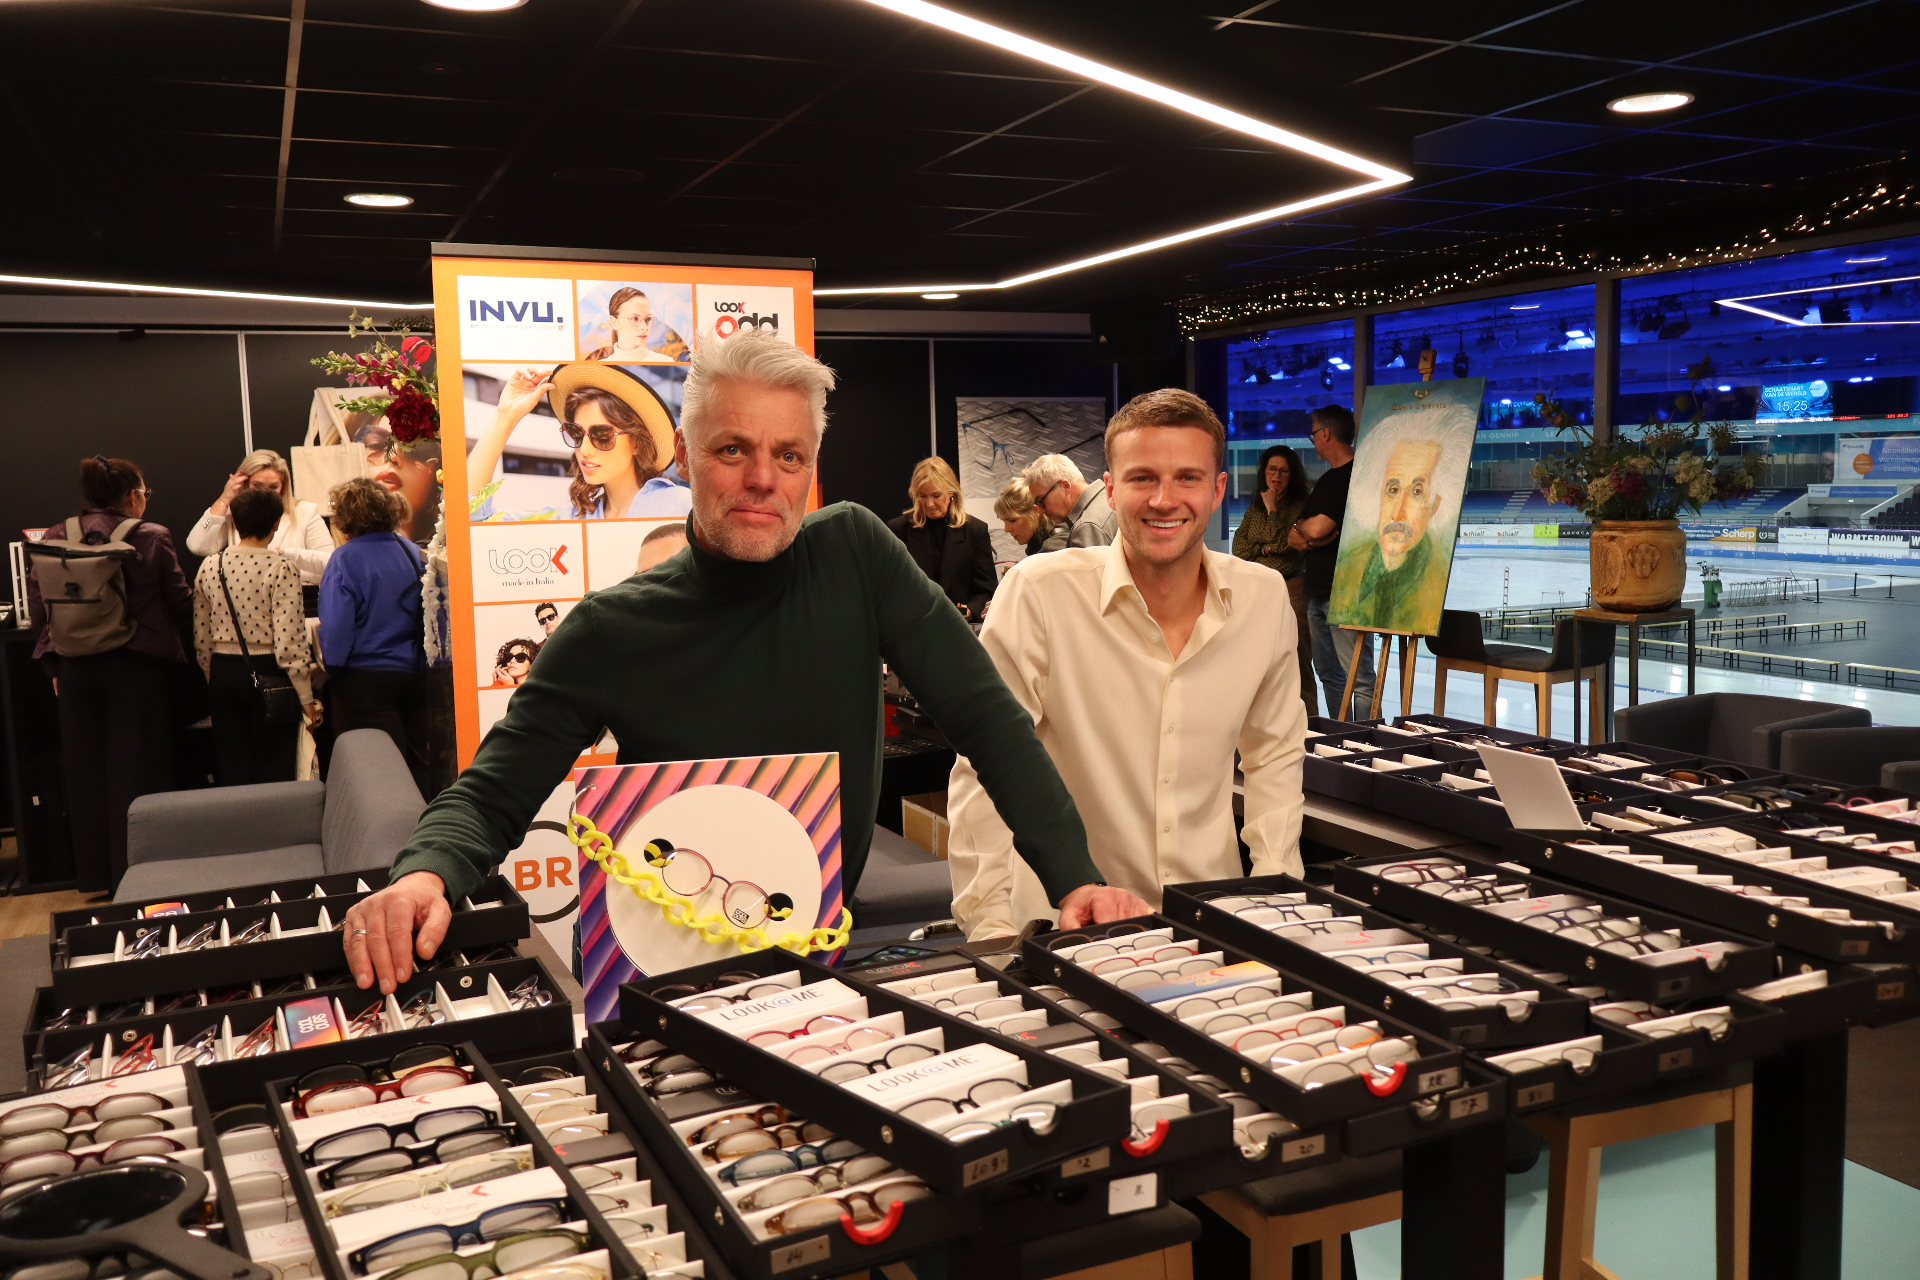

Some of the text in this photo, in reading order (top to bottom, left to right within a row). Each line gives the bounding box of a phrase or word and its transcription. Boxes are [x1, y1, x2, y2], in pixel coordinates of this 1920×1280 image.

[470, 300, 563, 323] INVU.
[714, 302, 746, 314] LOOK
[1776, 400, 1808, 412] 15:25
[1722, 528, 1756, 539] Scherp
[488, 544, 569, 575] LOOK
[502, 577, 555, 587] made in Italia
[514, 856, 574, 892] BR
[719, 987, 825, 1021] LOOK@ME
[866, 1054, 980, 1092] LOOK@ME
